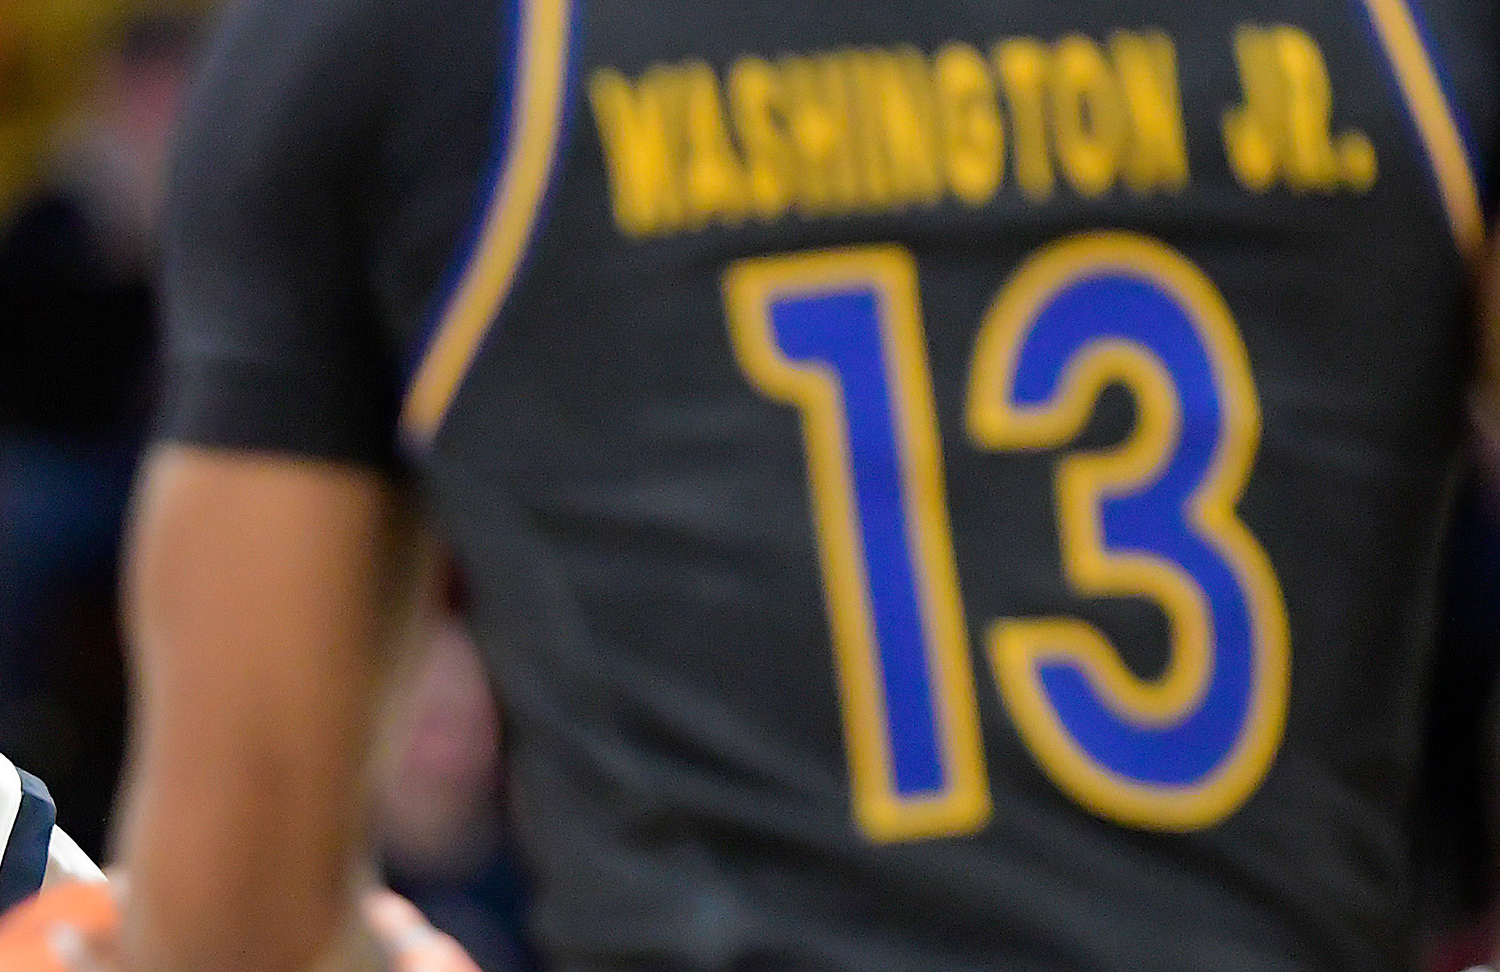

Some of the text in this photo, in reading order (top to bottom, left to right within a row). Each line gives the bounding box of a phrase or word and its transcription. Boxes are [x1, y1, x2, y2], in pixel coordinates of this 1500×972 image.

[590, 25, 1378, 235] WASHINGTON JR.
[722, 230, 1293, 844] 13
